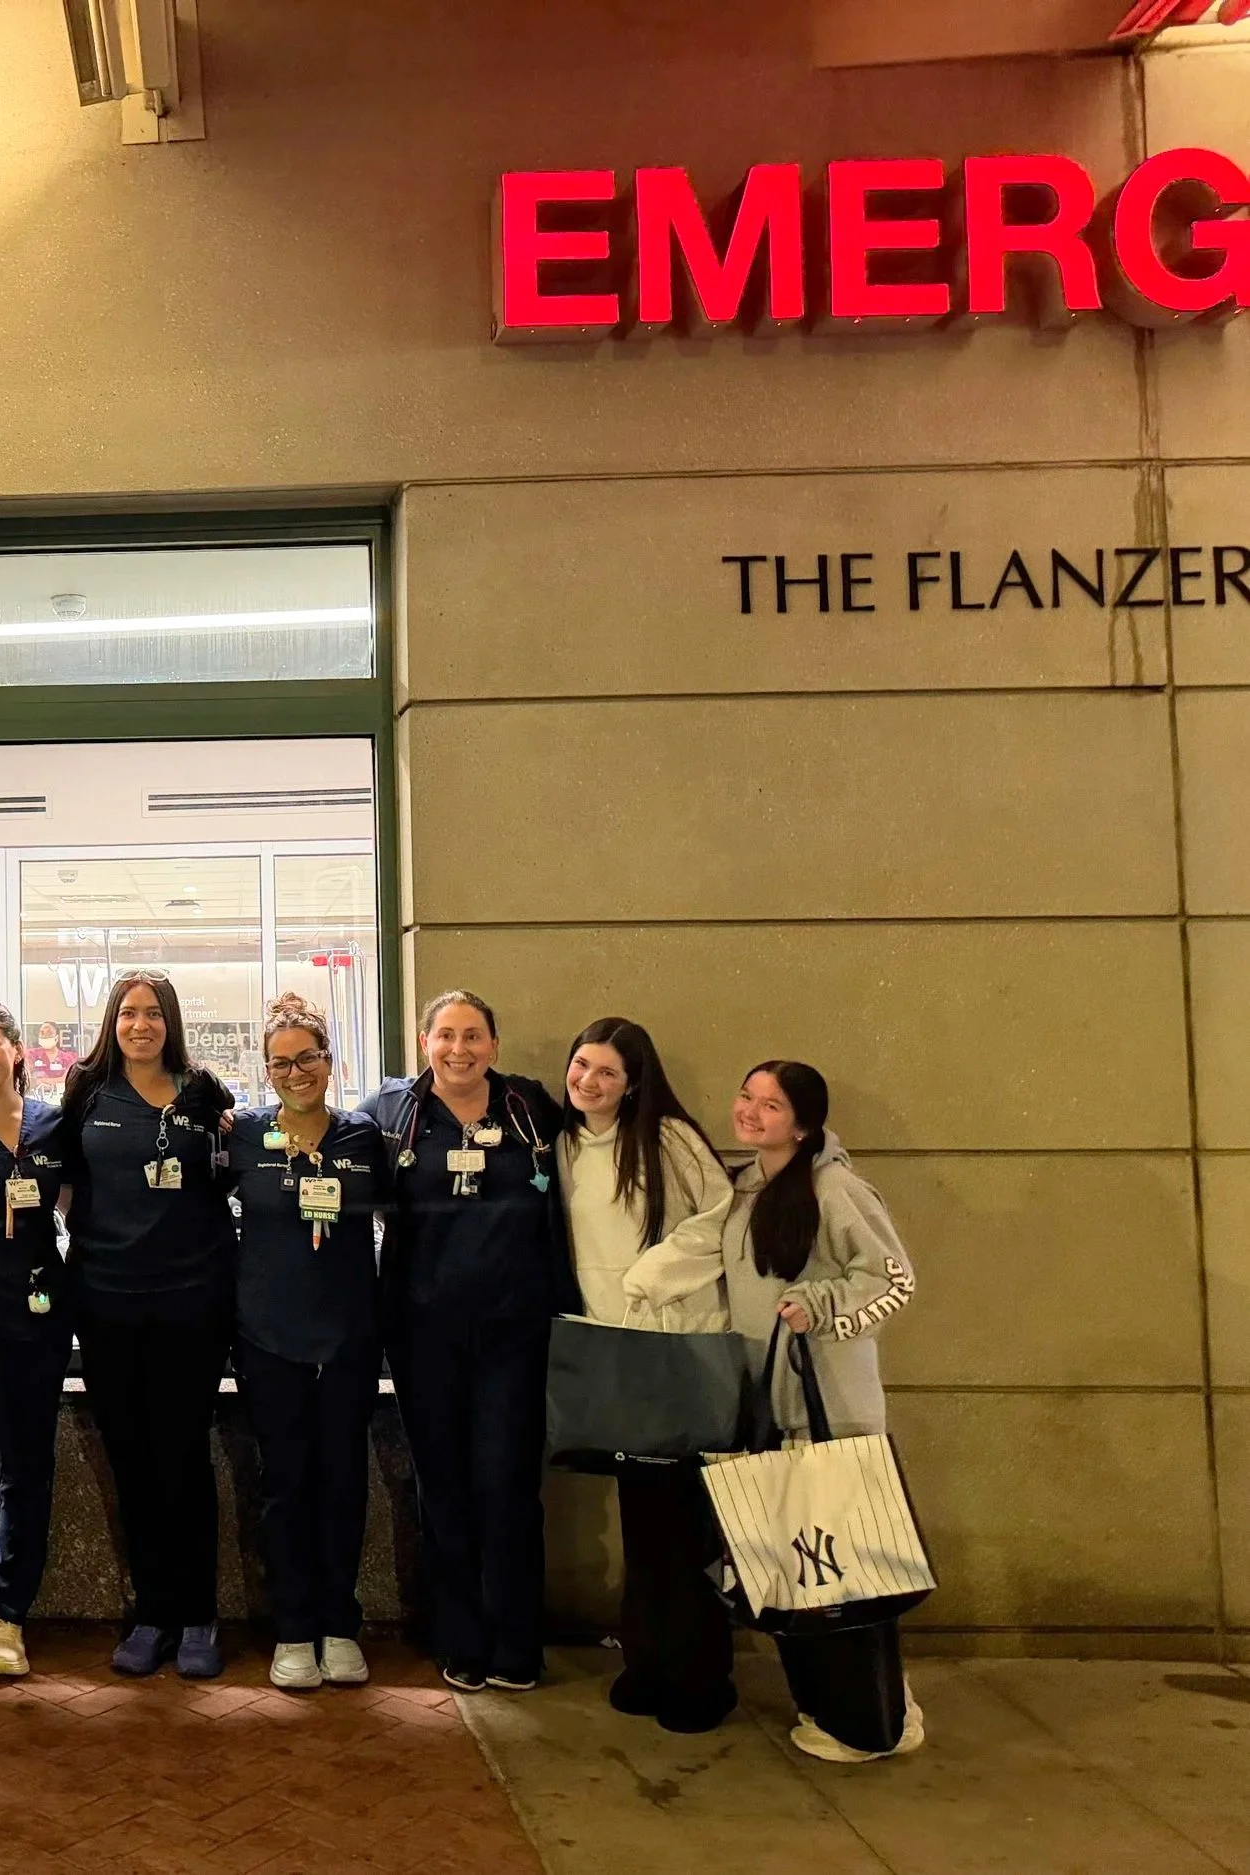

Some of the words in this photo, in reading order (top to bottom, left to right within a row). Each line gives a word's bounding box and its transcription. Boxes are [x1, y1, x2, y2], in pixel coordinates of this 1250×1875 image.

[498, 147, 1250, 330] EMERG
[722, 553, 876, 615] THE
[907, 545, 1250, 612] FLANZER
[179, 996, 206, 1007] spital
[303, 1210, 312, 1218] ED
[313, 1211, 336, 1220] NURSE
[791, 1526, 845, 1589] NY
